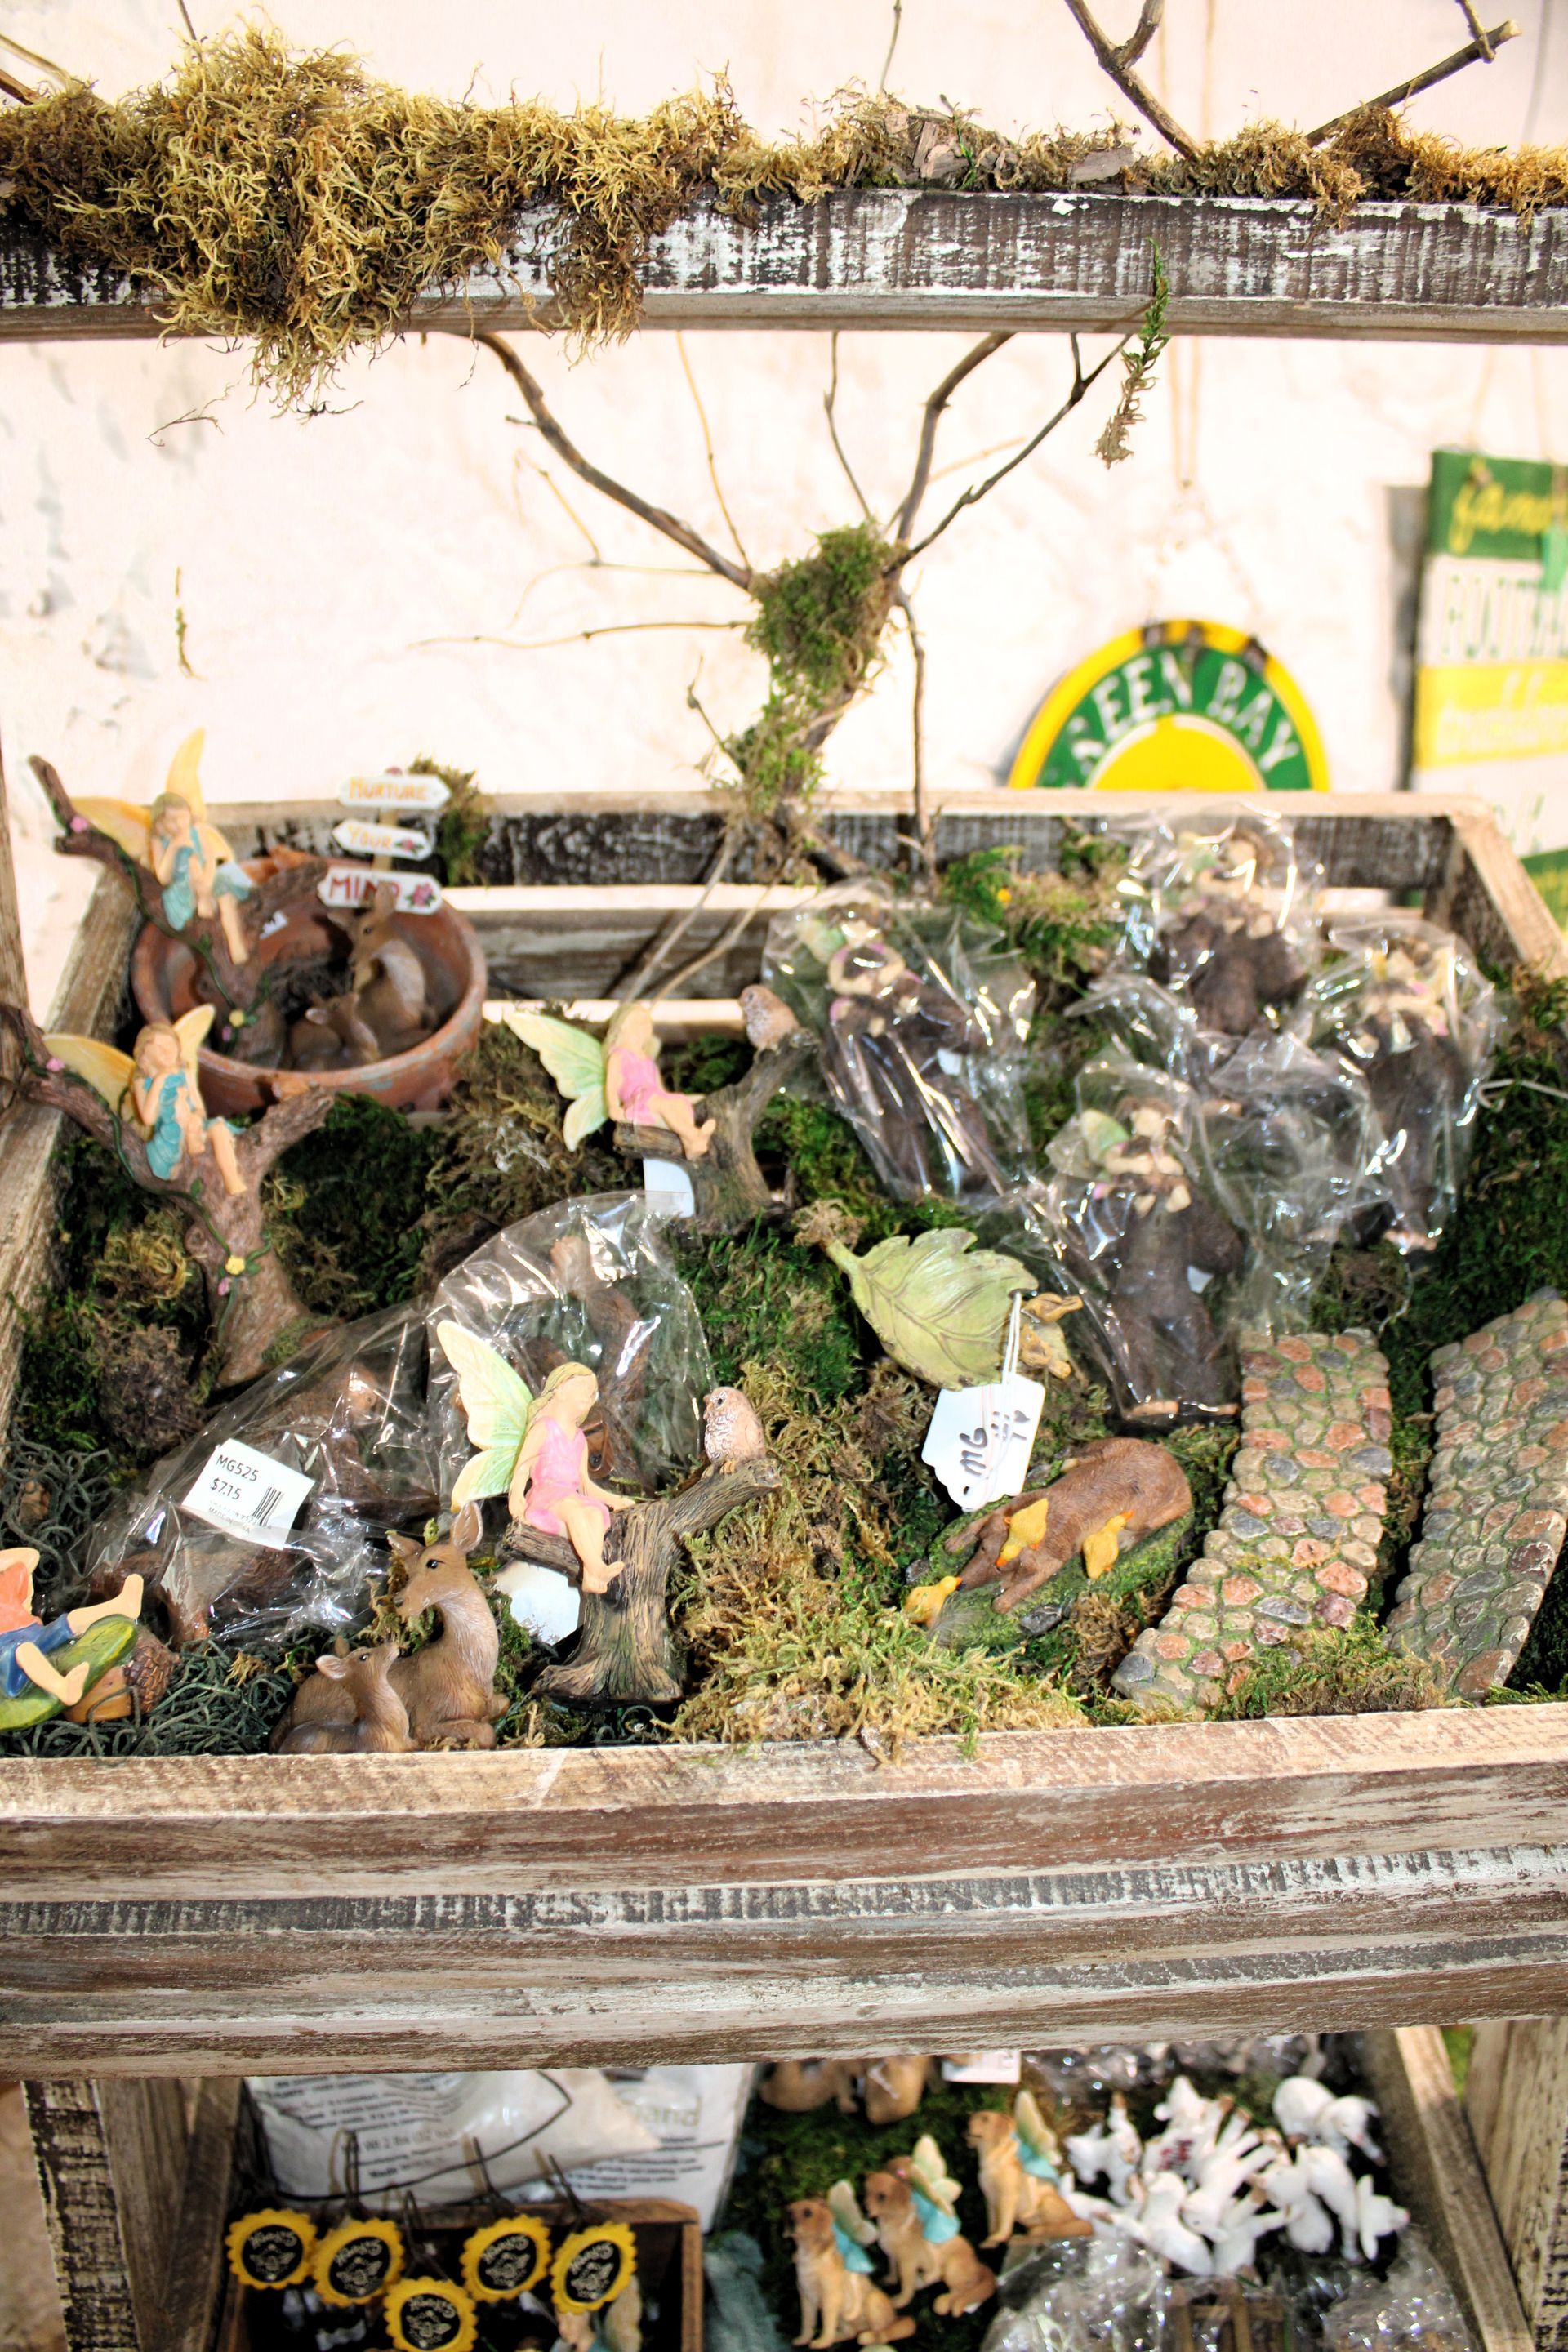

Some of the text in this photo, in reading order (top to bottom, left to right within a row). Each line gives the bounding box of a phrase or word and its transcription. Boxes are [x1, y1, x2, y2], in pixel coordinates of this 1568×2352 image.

[1207, 660, 1300, 773] BAY
[348, 777, 428, 801] NURTURE
[348, 824, 393, 850] YOUR
[216, 1454, 260, 1482] MG525
[210, 1477, 242, 1500] $7.15
